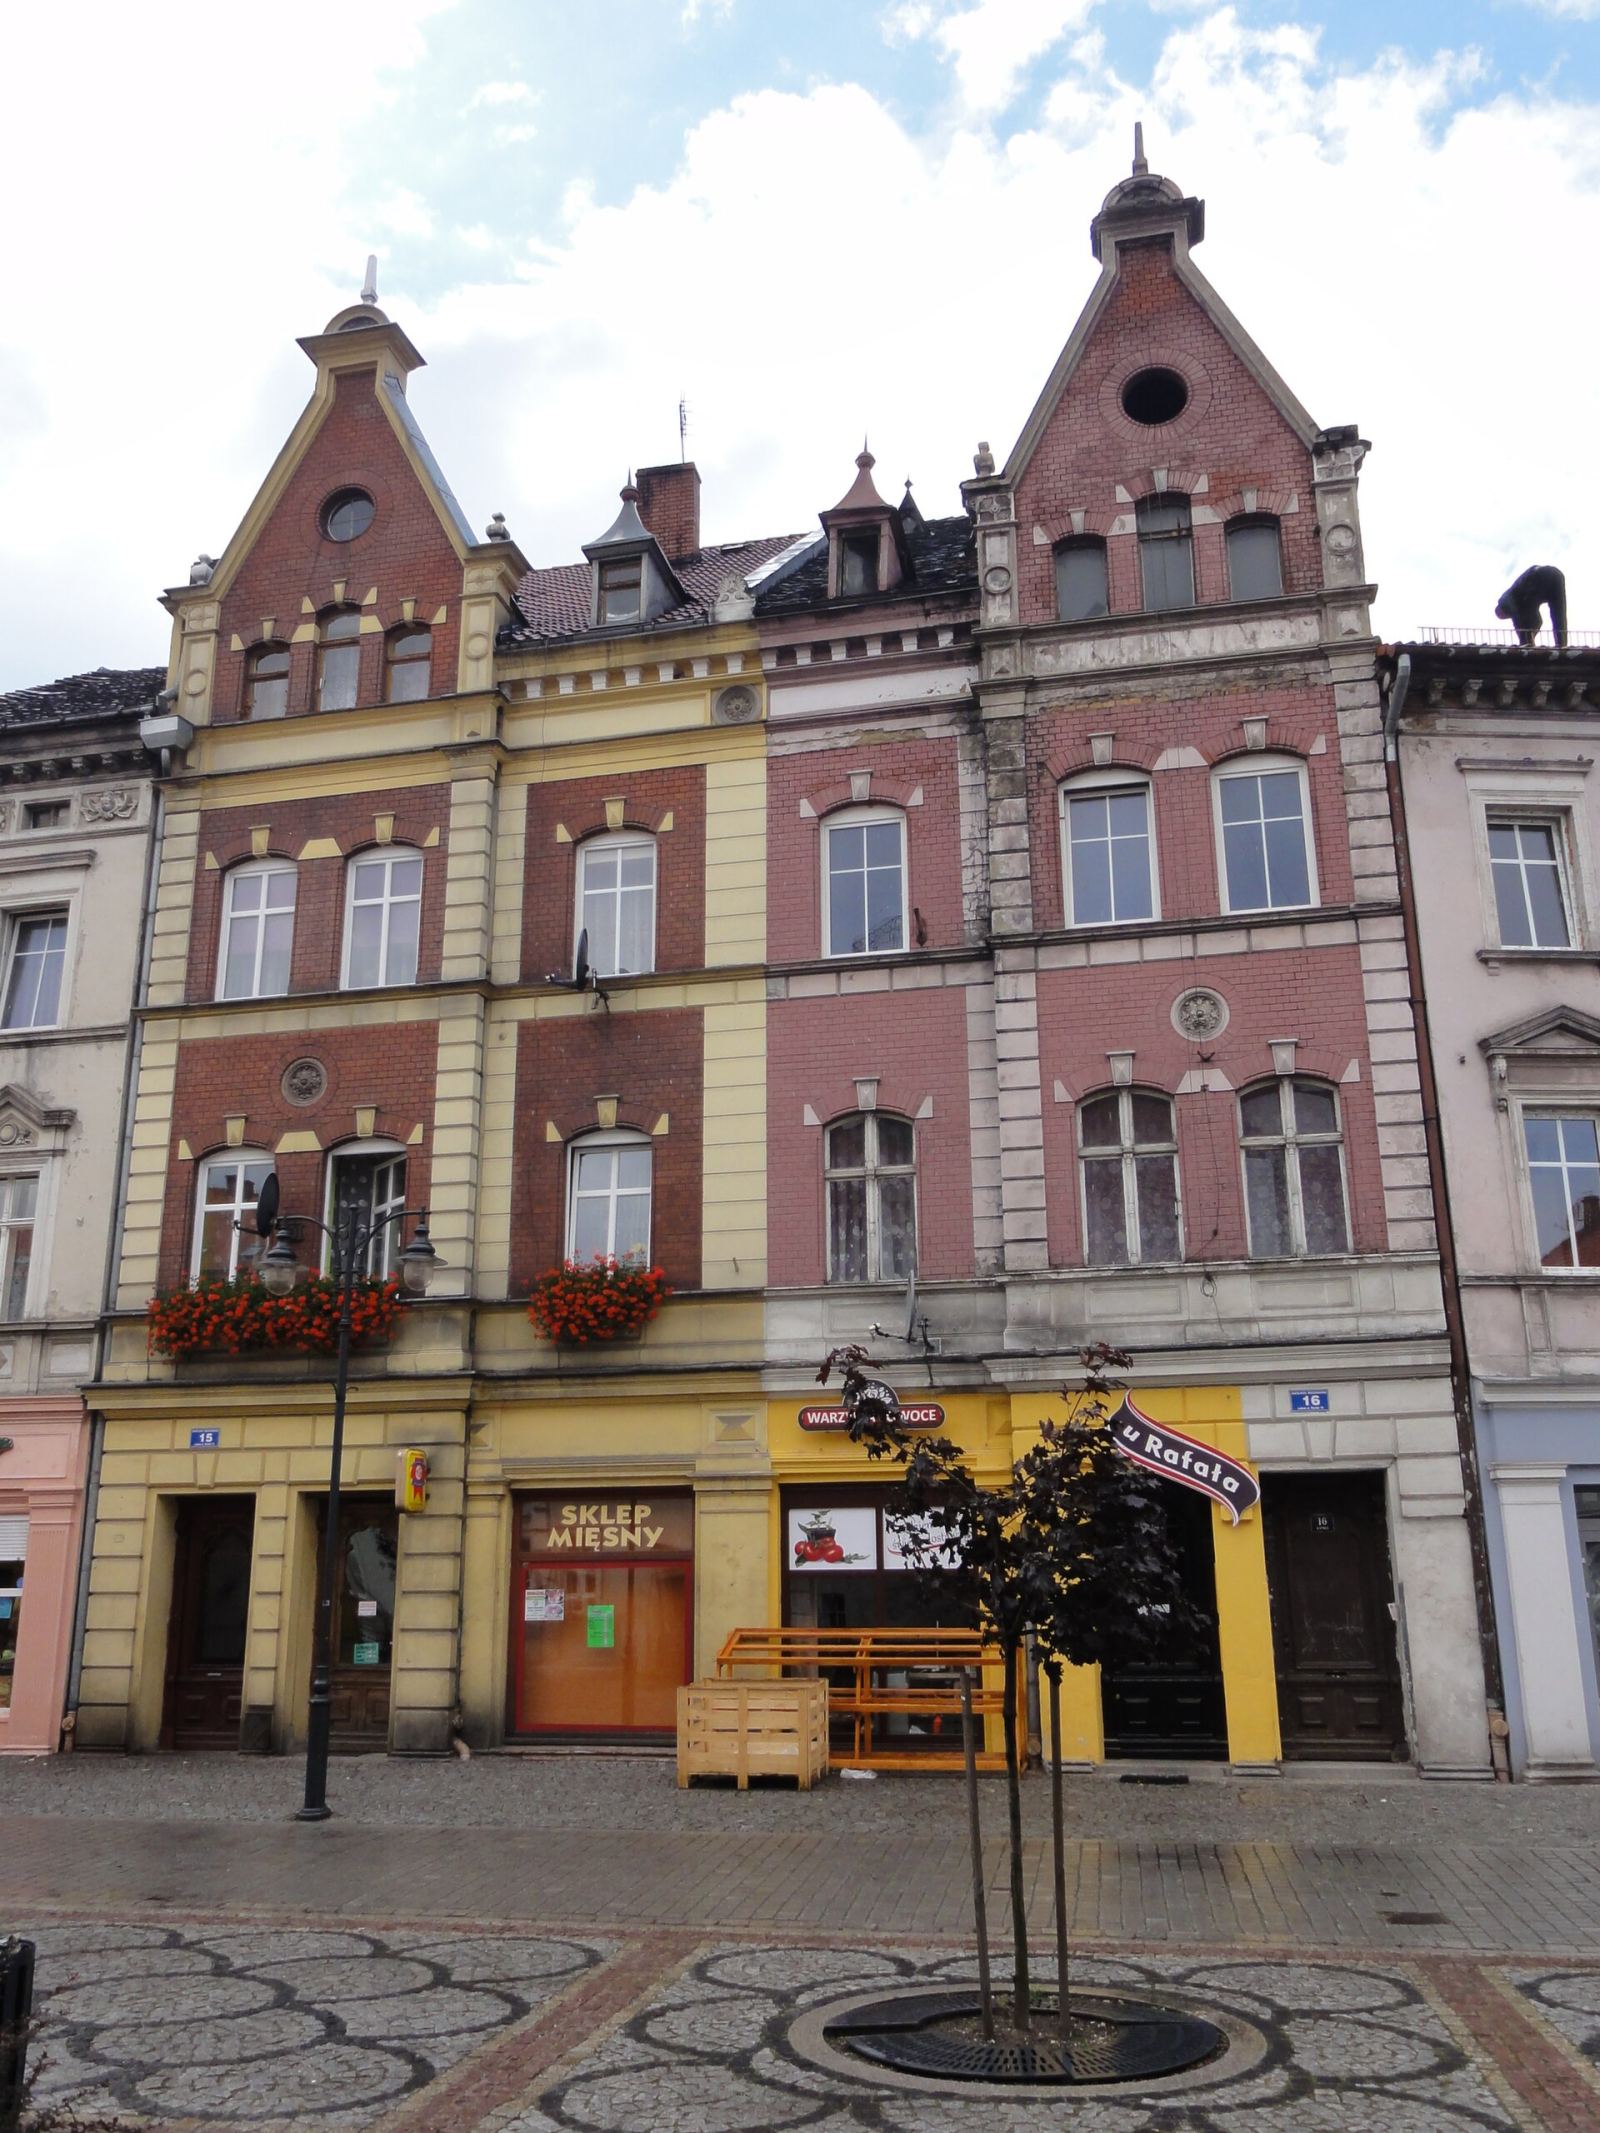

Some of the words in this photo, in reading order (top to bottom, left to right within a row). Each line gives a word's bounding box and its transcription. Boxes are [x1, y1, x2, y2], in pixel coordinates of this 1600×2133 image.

[1302, 1394, 1320, 1406] 16
[199, 1432, 213, 1443] 15
[1122, 1425, 1141, 1442] u
[1144, 1434, 1240, 1493] Rafała
[561, 1505, 652, 1525] SKLEP
[547, 1526, 664, 1552] MIĘSNY
